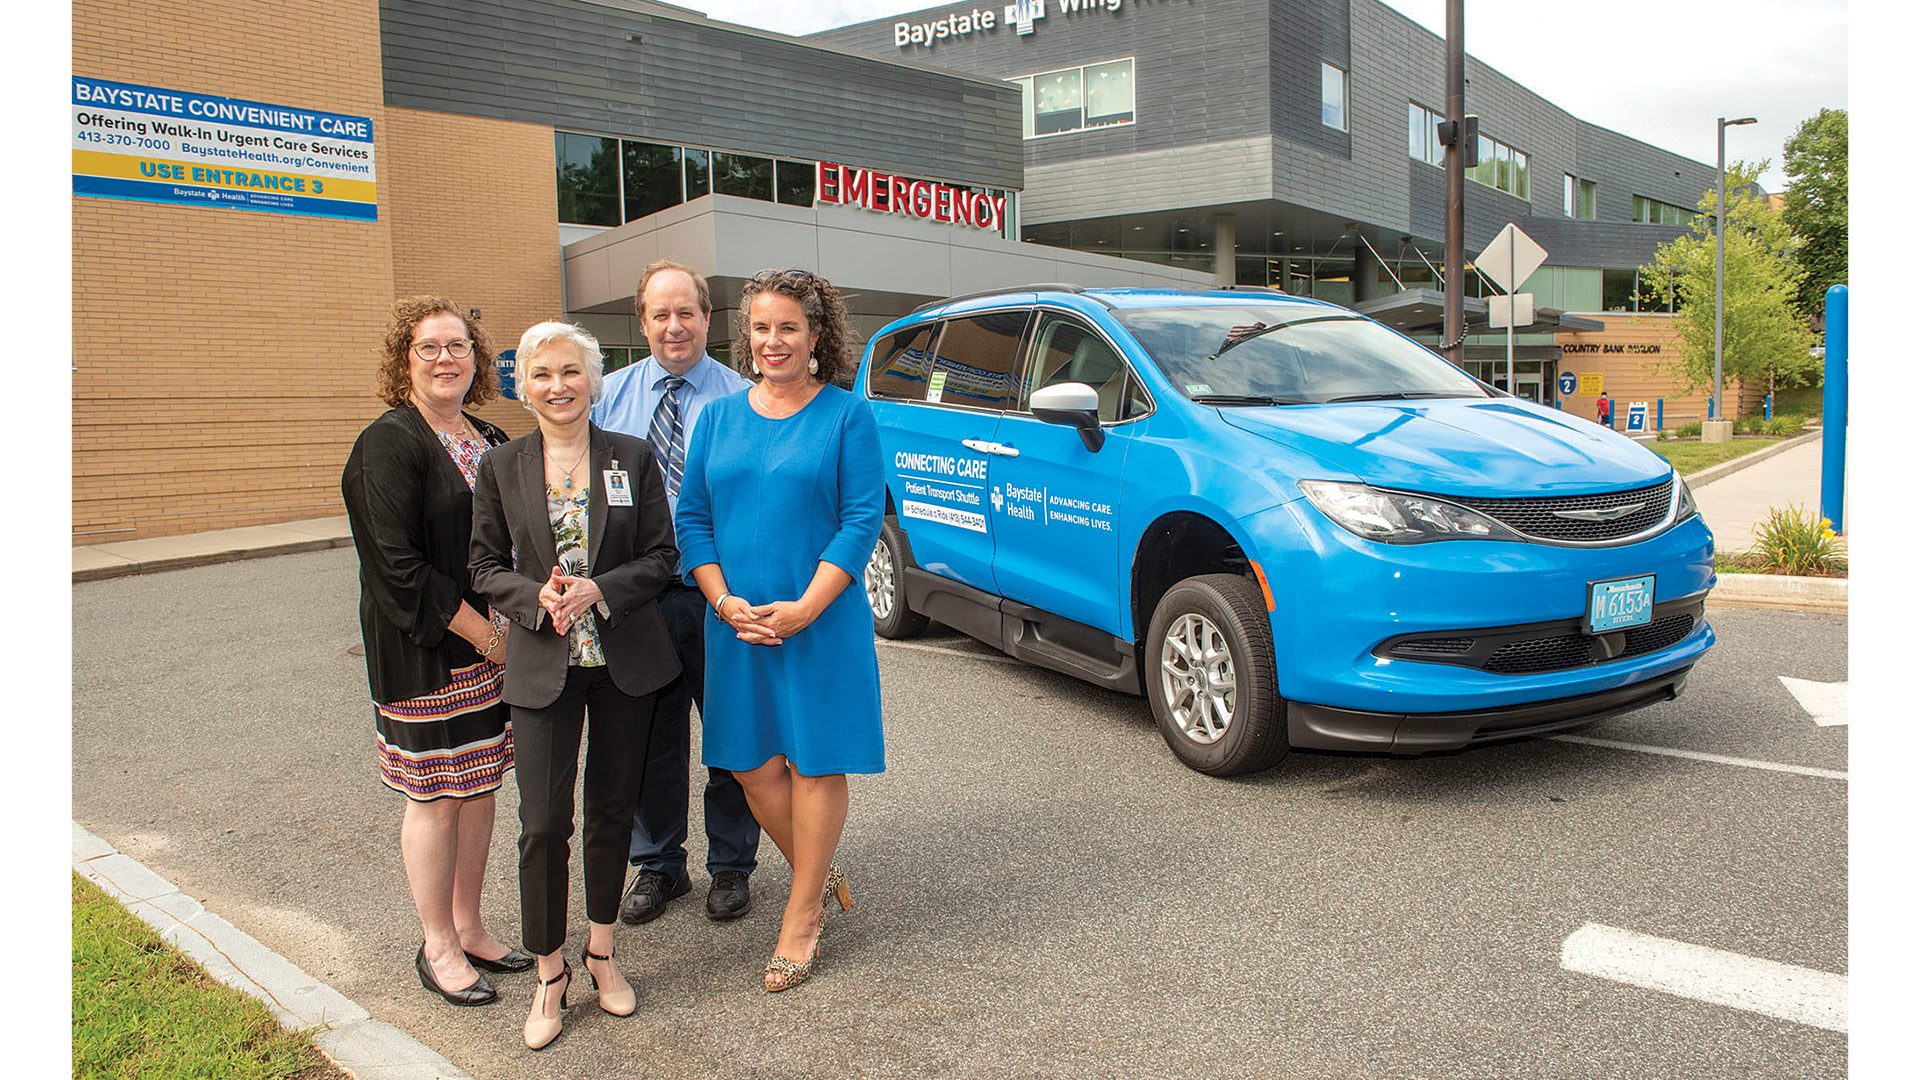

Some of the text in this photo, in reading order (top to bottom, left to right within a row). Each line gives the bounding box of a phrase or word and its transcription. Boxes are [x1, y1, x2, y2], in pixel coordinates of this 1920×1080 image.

[895, 9, 996, 47] Baystate
[76, 83, 367, 138] BAYSTATE CONVENIENT CARE
[77, 112, 369, 159] Offering Walk-In Urgent Care Services
[78, 130, 369, 174] 413-370-7000 BaystateHealth.org/Convenient
[140, 161, 323, 194] USE ENTRANCE 3
[173, 187, 246, 201] Baystate Health
[815, 160, 1007, 232] EMERGENCY
[1563, 344, 1601, 353] COUNTRY
[1603, 345, 1625, 353] BANK
[496, 360, 515, 368] ENTR
[1564, 381, 1571, 393] 2
[1633, 415, 1640, 425] 2
[895, 451, 987, 479] CONNECTING CARE
[906, 481, 980, 505] Patient Transport Shuttle
[1006, 482, 1042, 502] Baystate
[911, 505, 933, 517] Schedule
[1007, 502, 1035, 520] Health
[1049, 496, 1113, 515] ADVANCING CARE.
[1050, 511, 1113, 531] ENHANCING LIVES.
